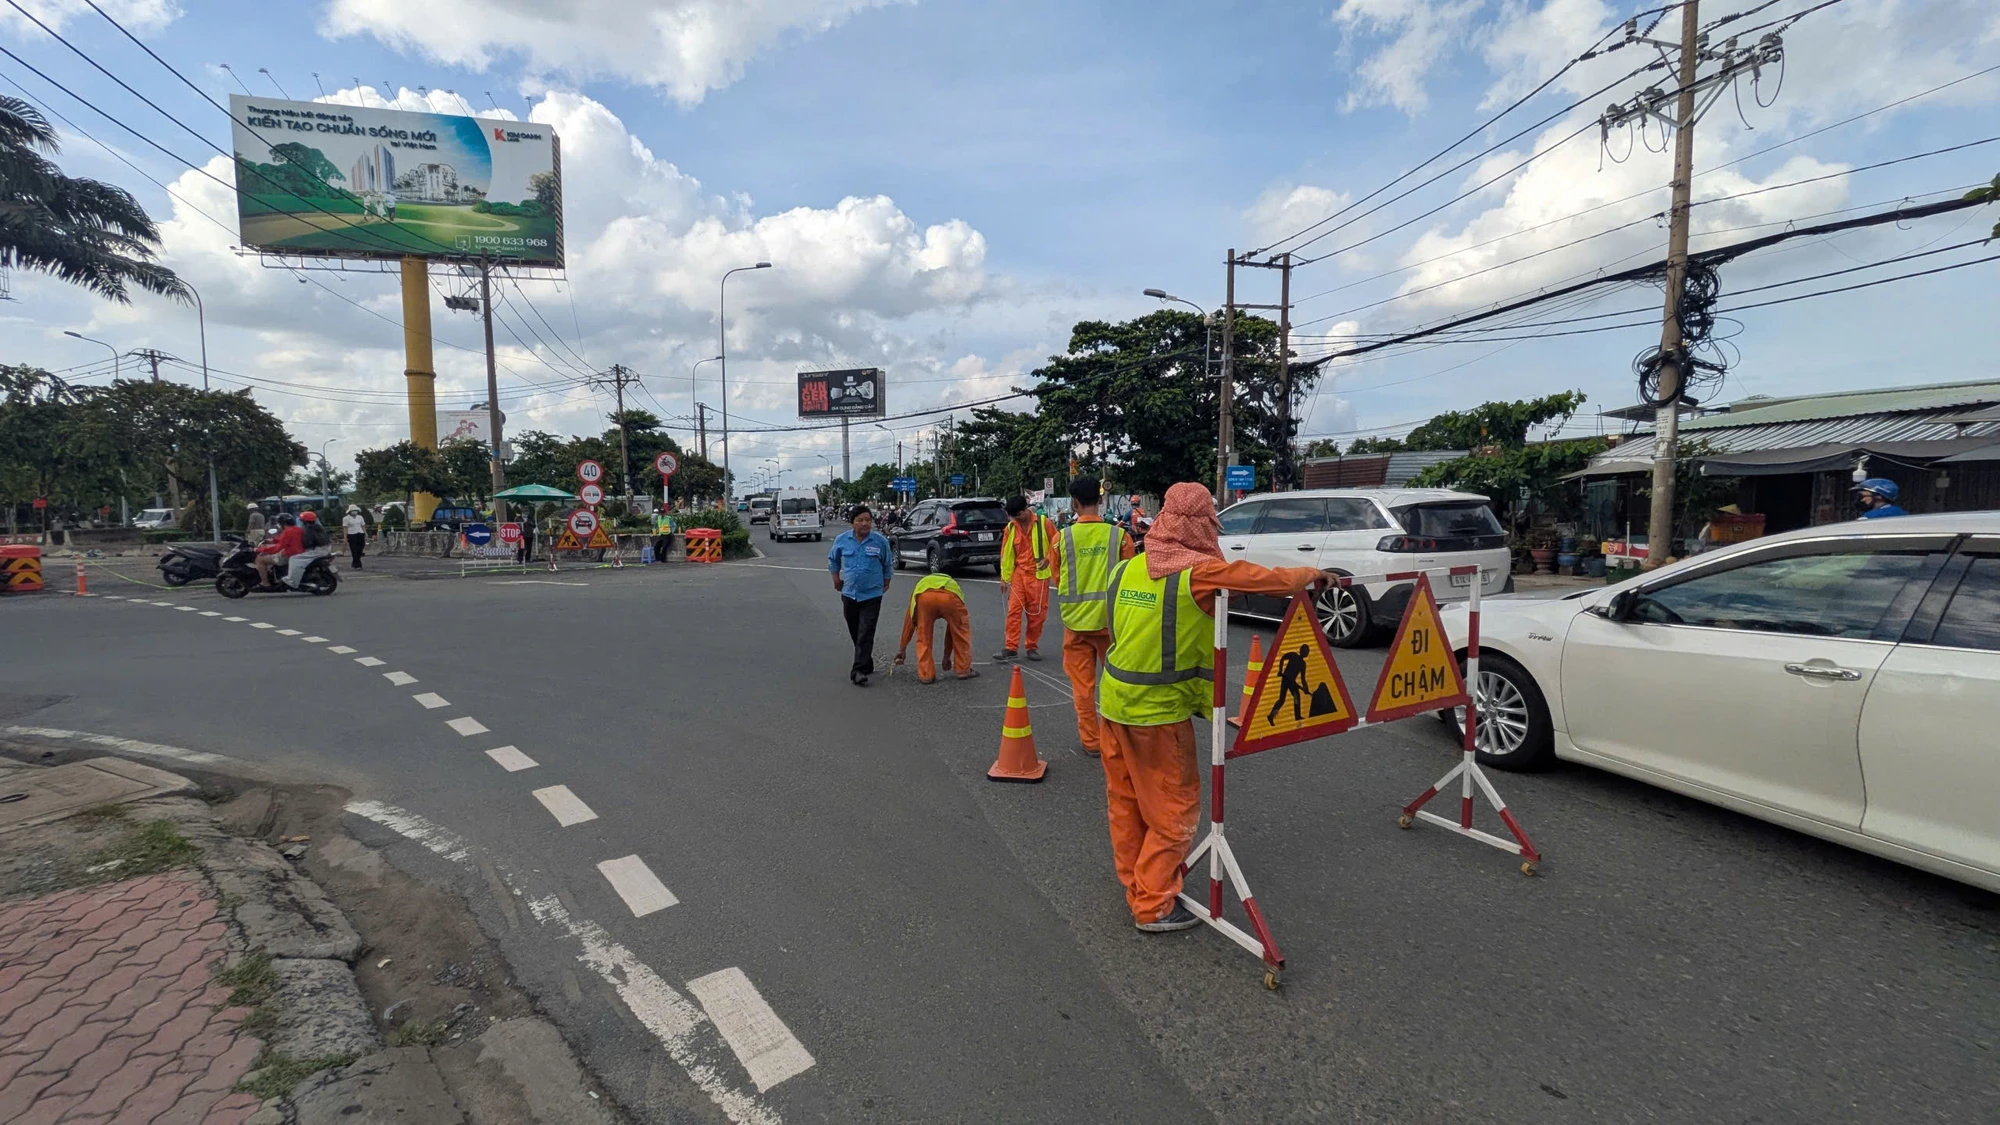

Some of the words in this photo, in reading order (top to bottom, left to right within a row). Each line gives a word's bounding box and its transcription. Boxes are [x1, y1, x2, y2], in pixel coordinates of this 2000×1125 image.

[247, 115, 282, 129] KIẾN
[284, 119, 313, 132] TẠO
[316, 121, 366, 136] CHUẨN
[368, 125, 408, 140] SỐNG
[474, 235, 501, 245] 1900
[502, 236, 524, 246] 633
[526, 238, 548, 247] 968
[583, 464, 597, 477] 40
[500, 528, 521, 538] STOP
[1411, 628, 1429, 655] ĐI
[1391, 664, 1445, 701] CHẬM
